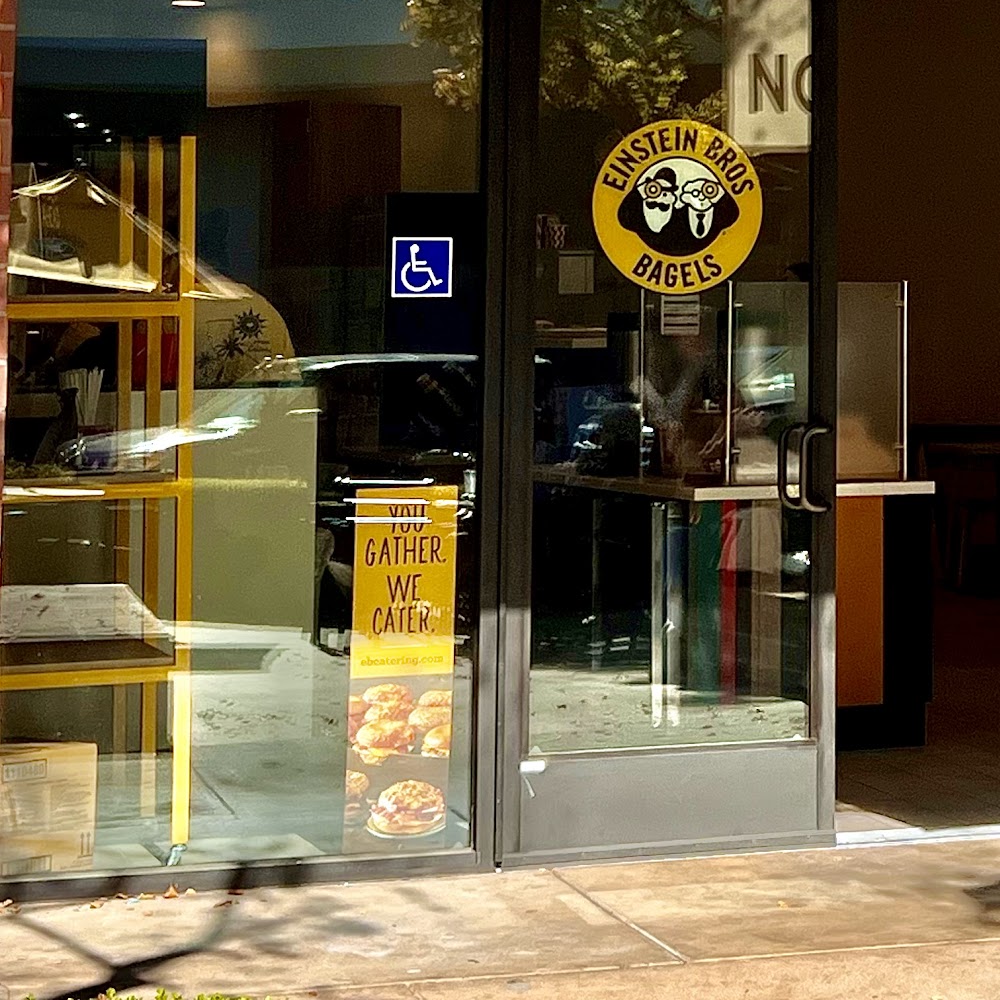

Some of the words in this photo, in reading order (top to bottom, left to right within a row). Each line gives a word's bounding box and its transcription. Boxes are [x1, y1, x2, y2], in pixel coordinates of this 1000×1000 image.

[602, 126, 698, 192] EINSTEIN
[704, 137, 755, 196] BROS
[632, 253, 722, 288] BAGELS
[389, 503, 427, 534] YOU
[365, 536, 447, 566] GATHER.
[387, 574, 422, 603] WE
[372, 606, 435, 635] CATER.
[360, 655, 444, 667] ebcatering.com
